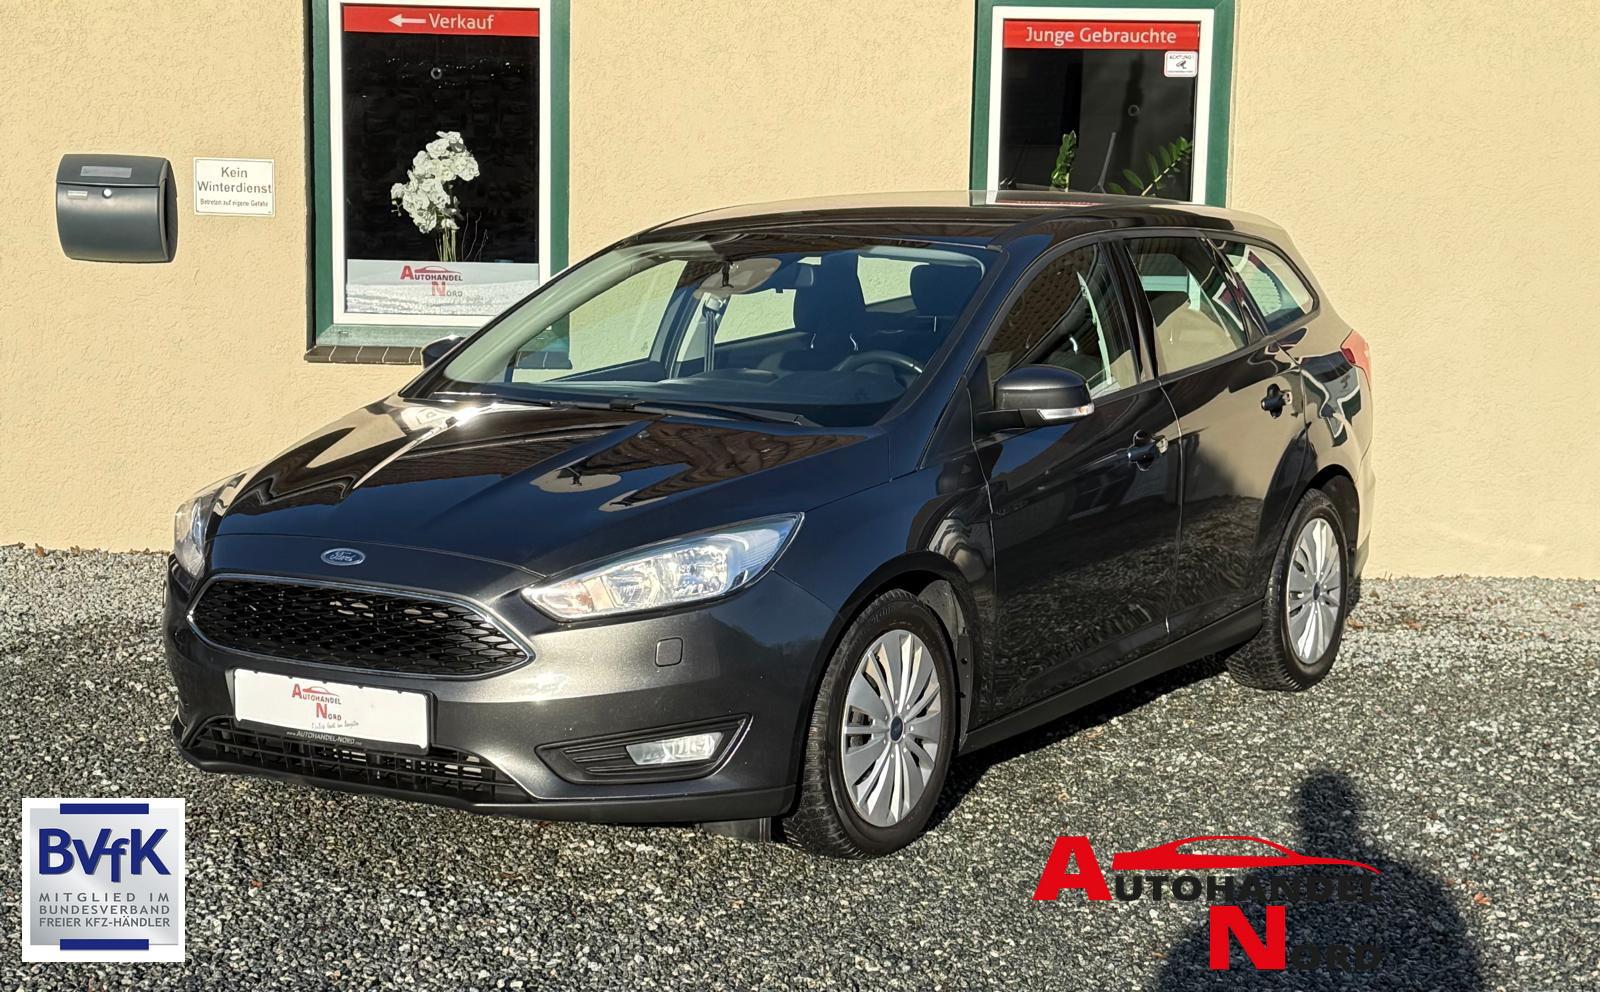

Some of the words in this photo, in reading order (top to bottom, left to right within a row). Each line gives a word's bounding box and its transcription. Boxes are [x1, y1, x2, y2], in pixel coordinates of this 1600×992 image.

[429, 13, 495, 29] Verkauf
[1025, 27, 1074, 46] Junge
[1080, 29, 1177, 44] Gebrauchte
[221, 166, 248, 178] Kein
[197, 181, 272, 193] Winterdienst
[200, 198, 222, 206] Betreten
[400, 265, 463, 282] AUTOHANDEL
[431, 281, 463, 297] NORD
[329, 551, 357, 562] Ford
[292, 683, 342, 705] AUTOHANDEL
[316, 702, 342, 721] NORD
